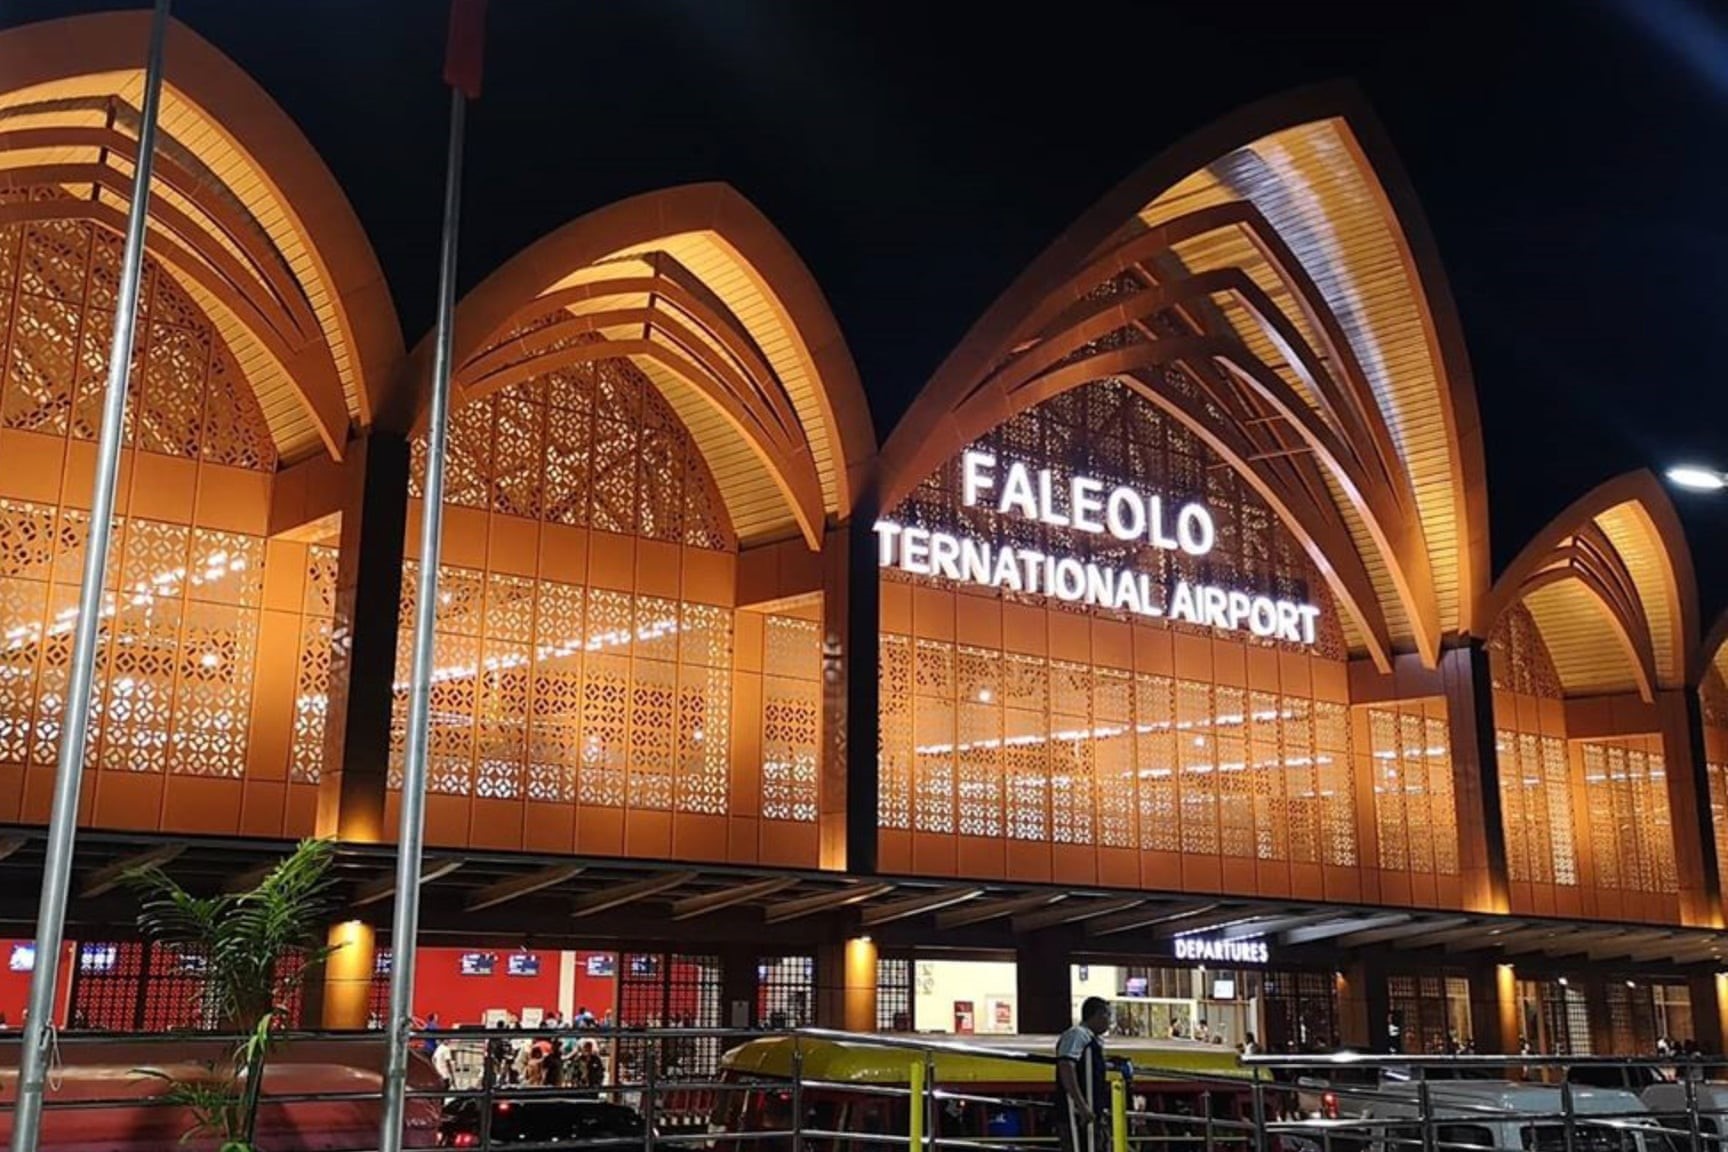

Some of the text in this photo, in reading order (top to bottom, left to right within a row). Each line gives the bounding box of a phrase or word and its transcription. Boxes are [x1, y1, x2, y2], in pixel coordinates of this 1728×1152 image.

[962, 450, 1214, 555] FALEOLO
[1170, 582, 1320, 644] AIRPORT
[1174, 938, 1269, 963] DEPARTURES
